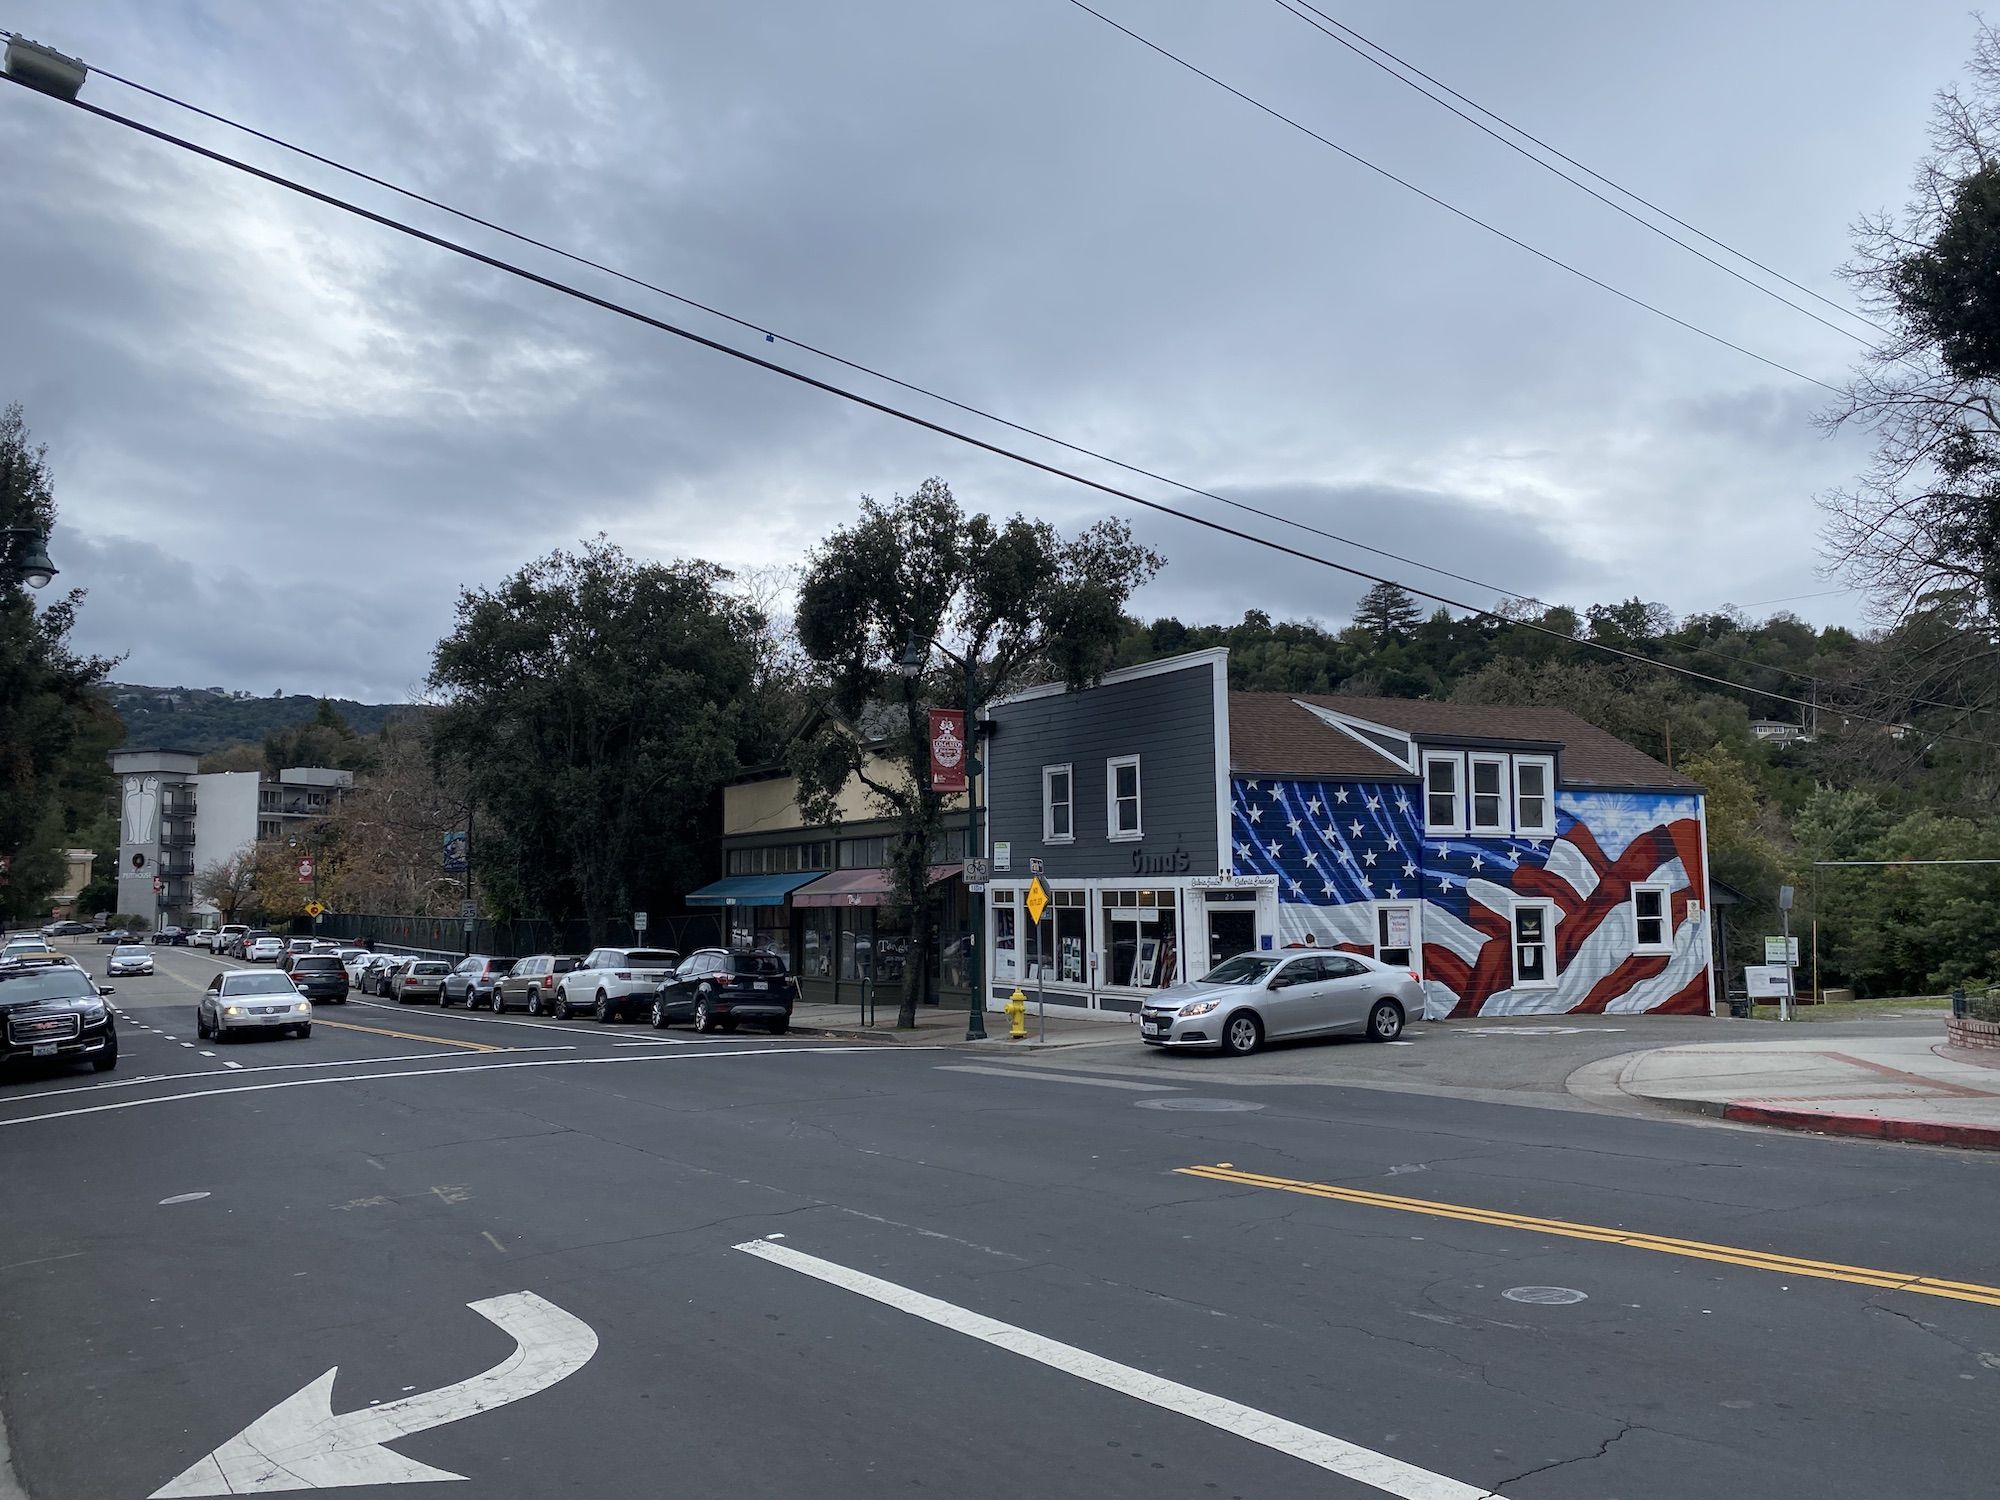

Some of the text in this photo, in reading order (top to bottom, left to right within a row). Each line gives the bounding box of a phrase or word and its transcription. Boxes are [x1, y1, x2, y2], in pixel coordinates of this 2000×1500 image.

[1131, 848, 1191, 873] Gina's
[1224, 893, 1235, 901] 25
[462, 909, 476, 918] 25
